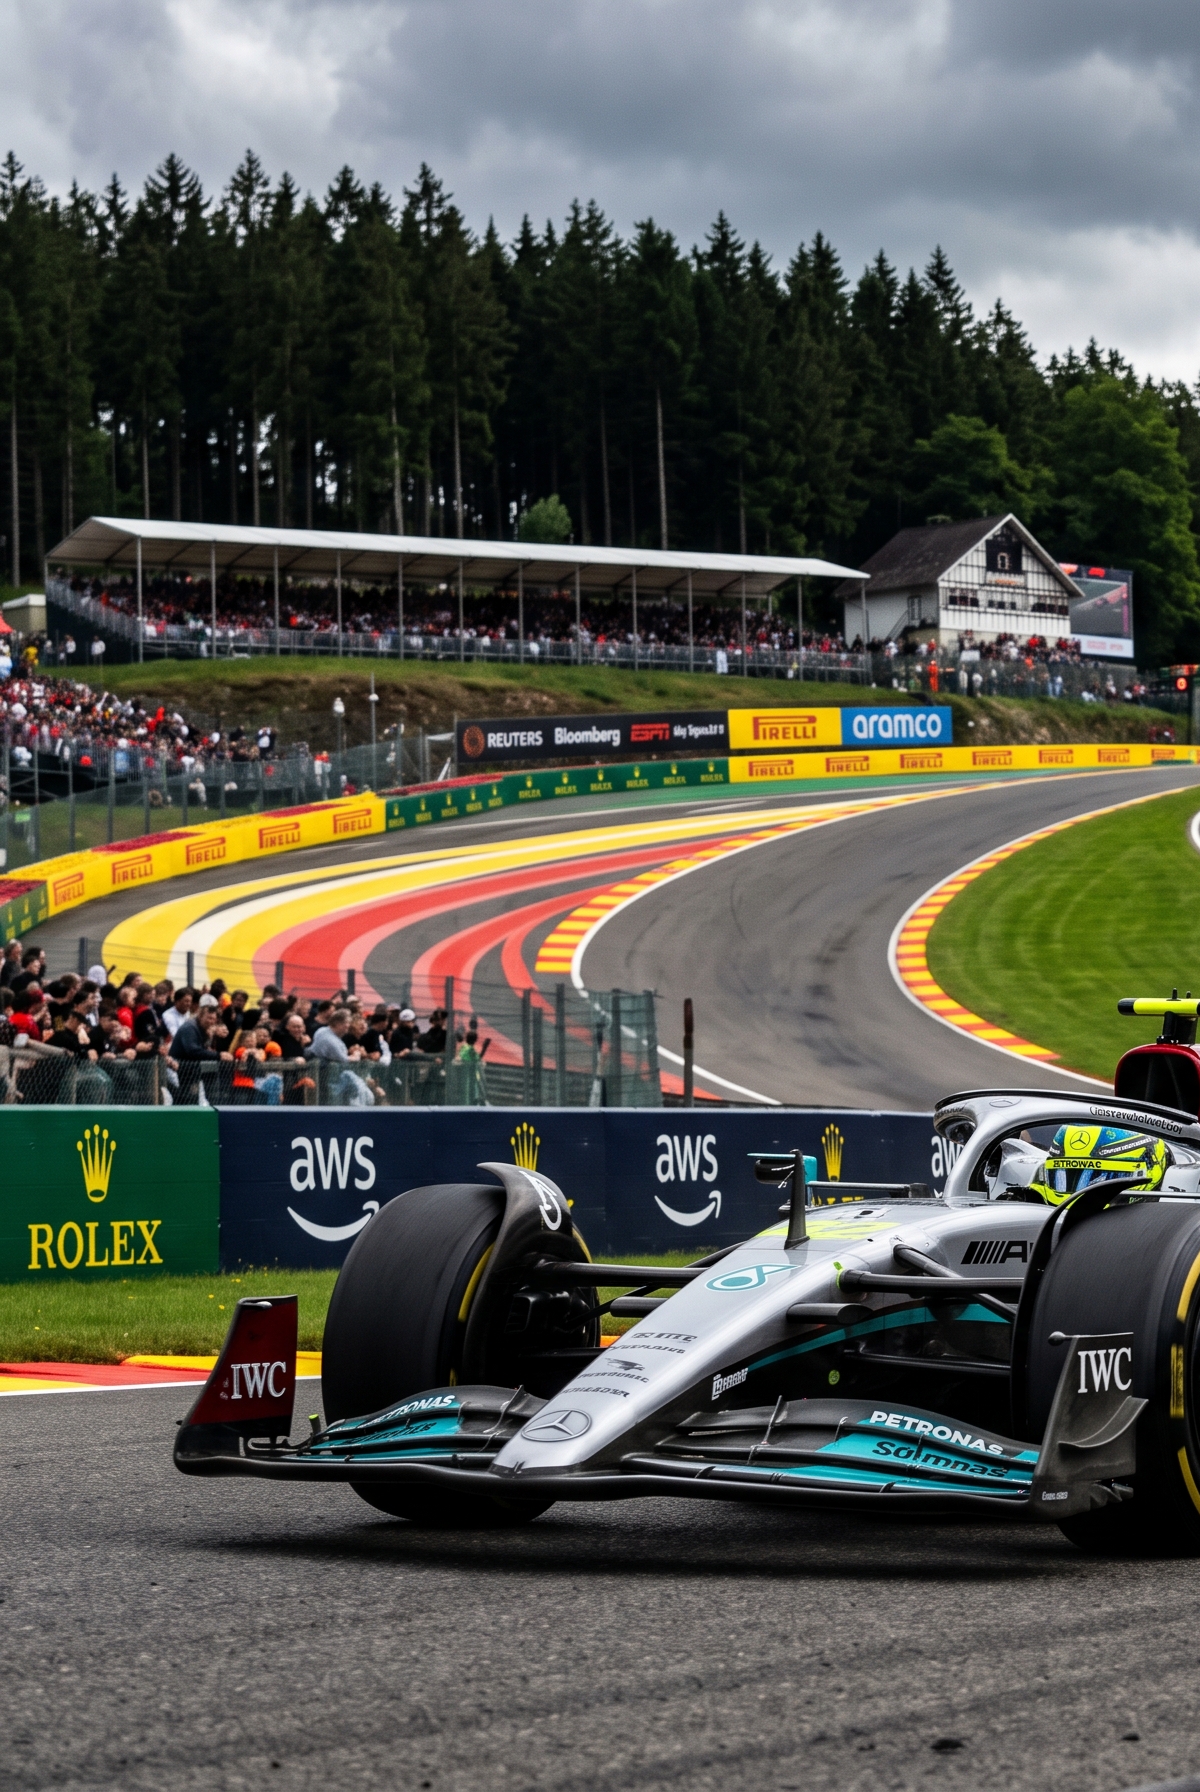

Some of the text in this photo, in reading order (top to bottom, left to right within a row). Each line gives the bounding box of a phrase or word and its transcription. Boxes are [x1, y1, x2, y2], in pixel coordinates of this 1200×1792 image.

[487, 727, 621, 749] REUTERS Bloomberg
[753, 715, 817, 740] PIRELLI
[852, 713, 942, 739] aramco
[289, 1136, 376, 1192] aws
[655, 1134, 719, 1183] aws
[931, 1135, 964, 1178] aw
[27, 1220, 163, 1270] ROLEX
[230, 1361, 287, 1399] IWC
[1077, 1347, 1132, 1394] IWC
[869, 1410, 1004, 1456] PETRONAS
